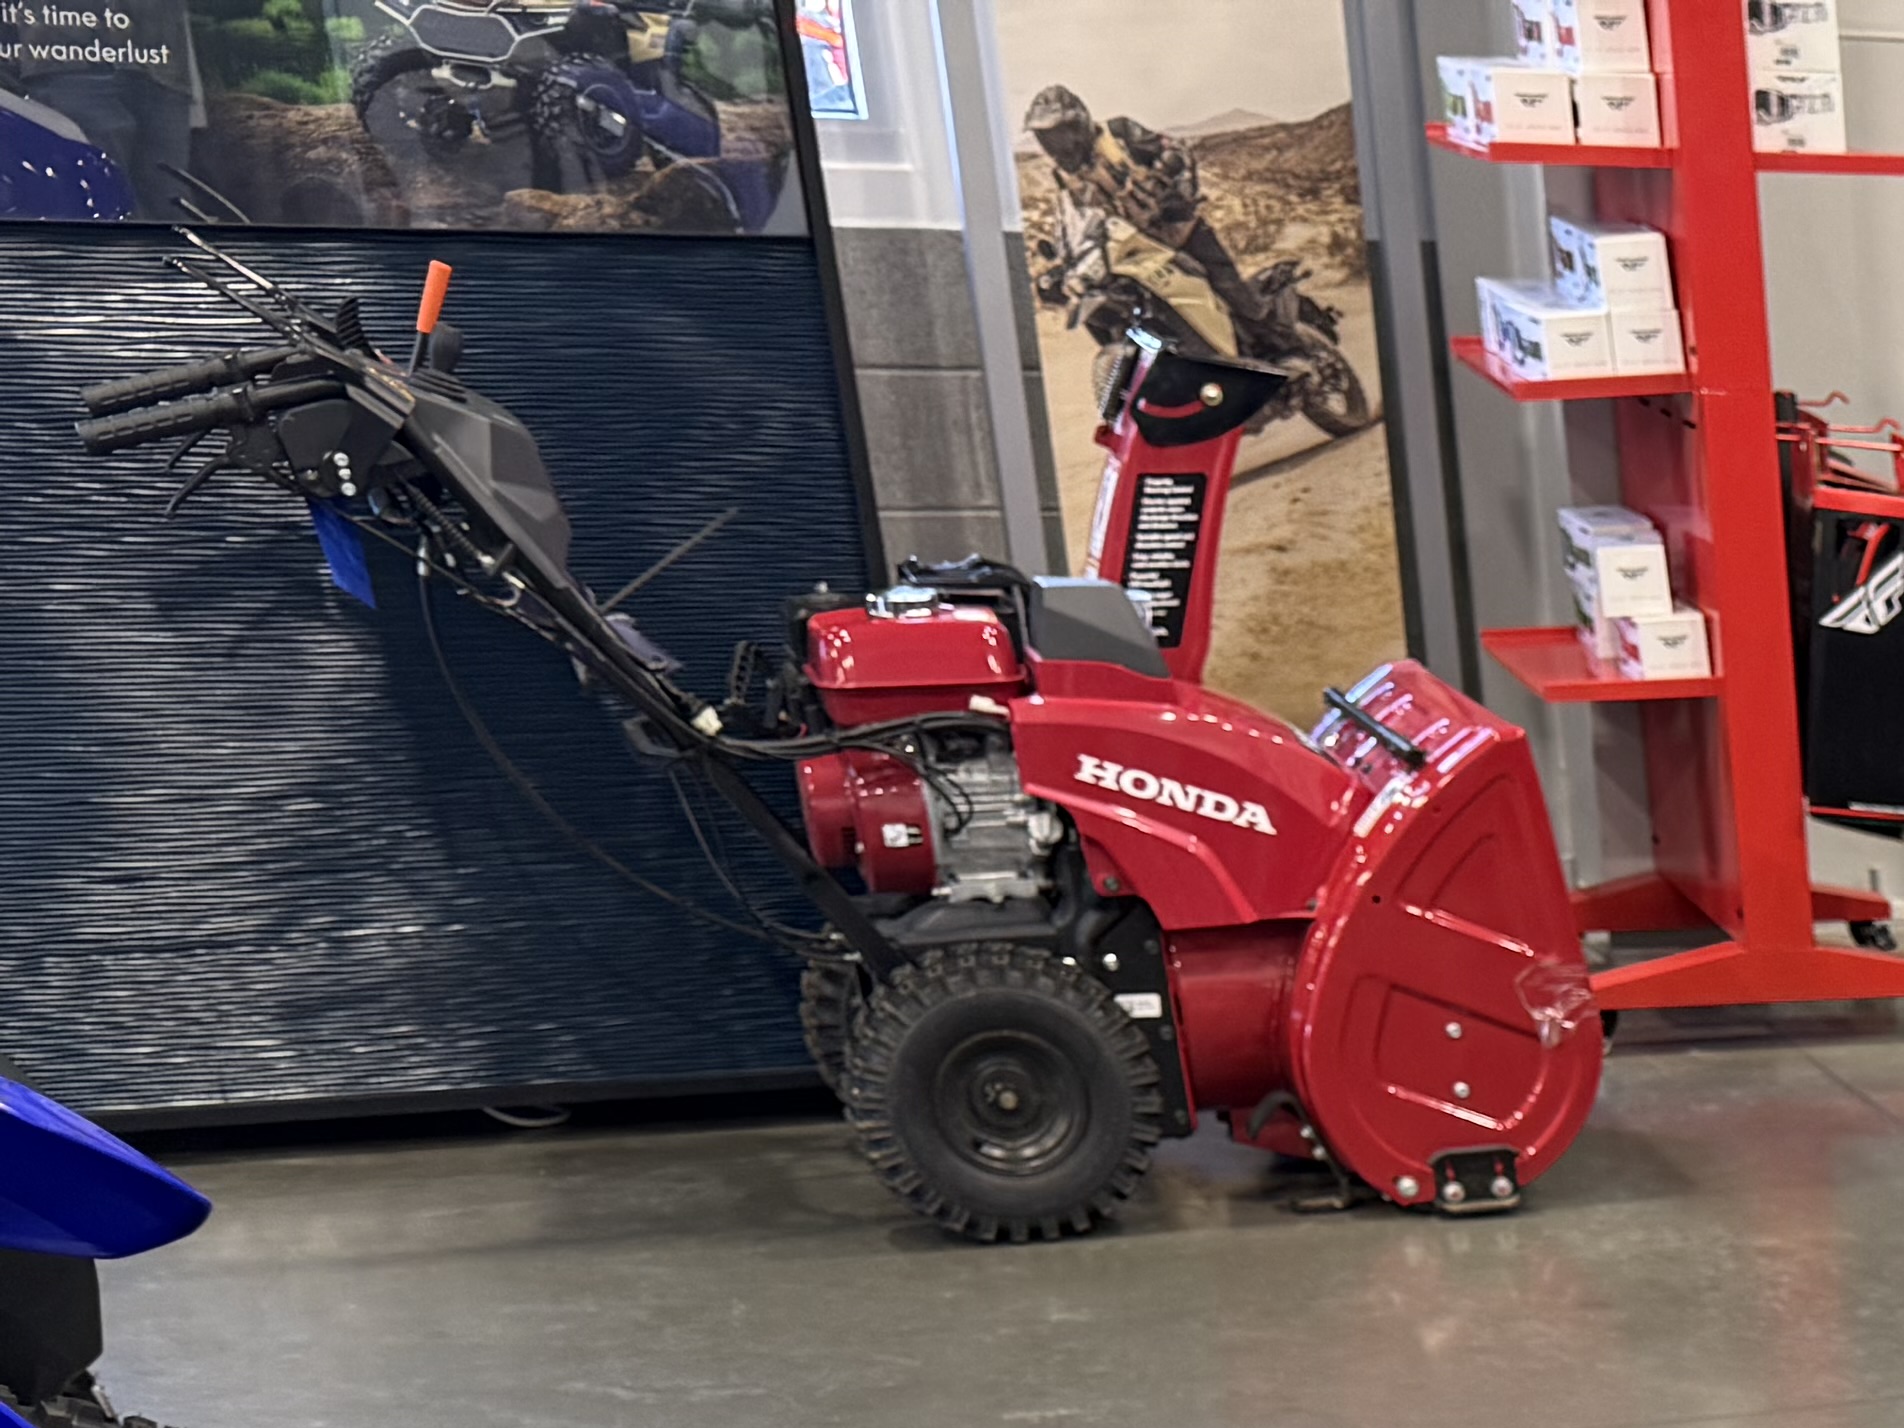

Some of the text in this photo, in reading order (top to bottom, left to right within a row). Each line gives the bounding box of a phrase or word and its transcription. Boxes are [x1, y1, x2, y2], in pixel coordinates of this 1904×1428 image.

[1, 2, 130, 29] it's time to
[29, 38, 170, 64] wanderlust
[1073, 753, 1278, 836] HONDA
